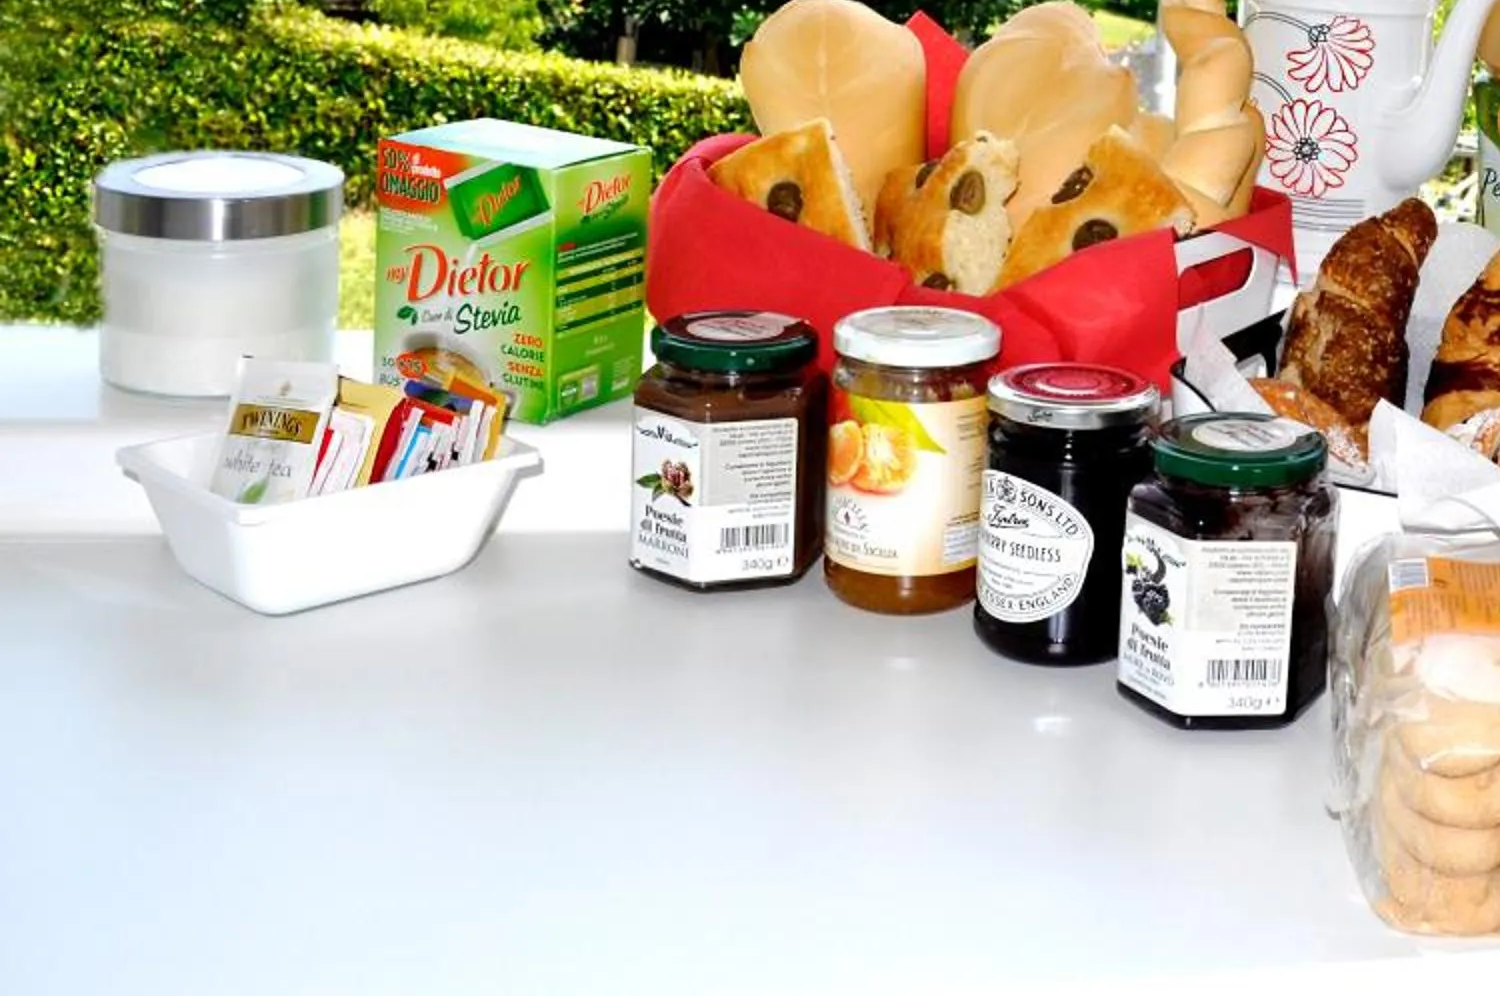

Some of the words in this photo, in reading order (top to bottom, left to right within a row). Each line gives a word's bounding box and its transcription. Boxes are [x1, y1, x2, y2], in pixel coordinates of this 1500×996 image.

[404, 243, 531, 302] Dietor
[453, 301, 522, 334] Stevia
[501, 345, 545, 362] CALORIE
[514, 332, 544, 348] ZERO
[507, 361, 544, 377] SENZA
[223, 450, 261, 474] white
[269, 459, 292, 478] tea
[1020, 490, 1056, 517] SONS
[1055, 511, 1080, 536] LTD
[1009, 541, 1062, 563] SEEDLESS
[1018, 576, 1075, 611] ENGLAND
